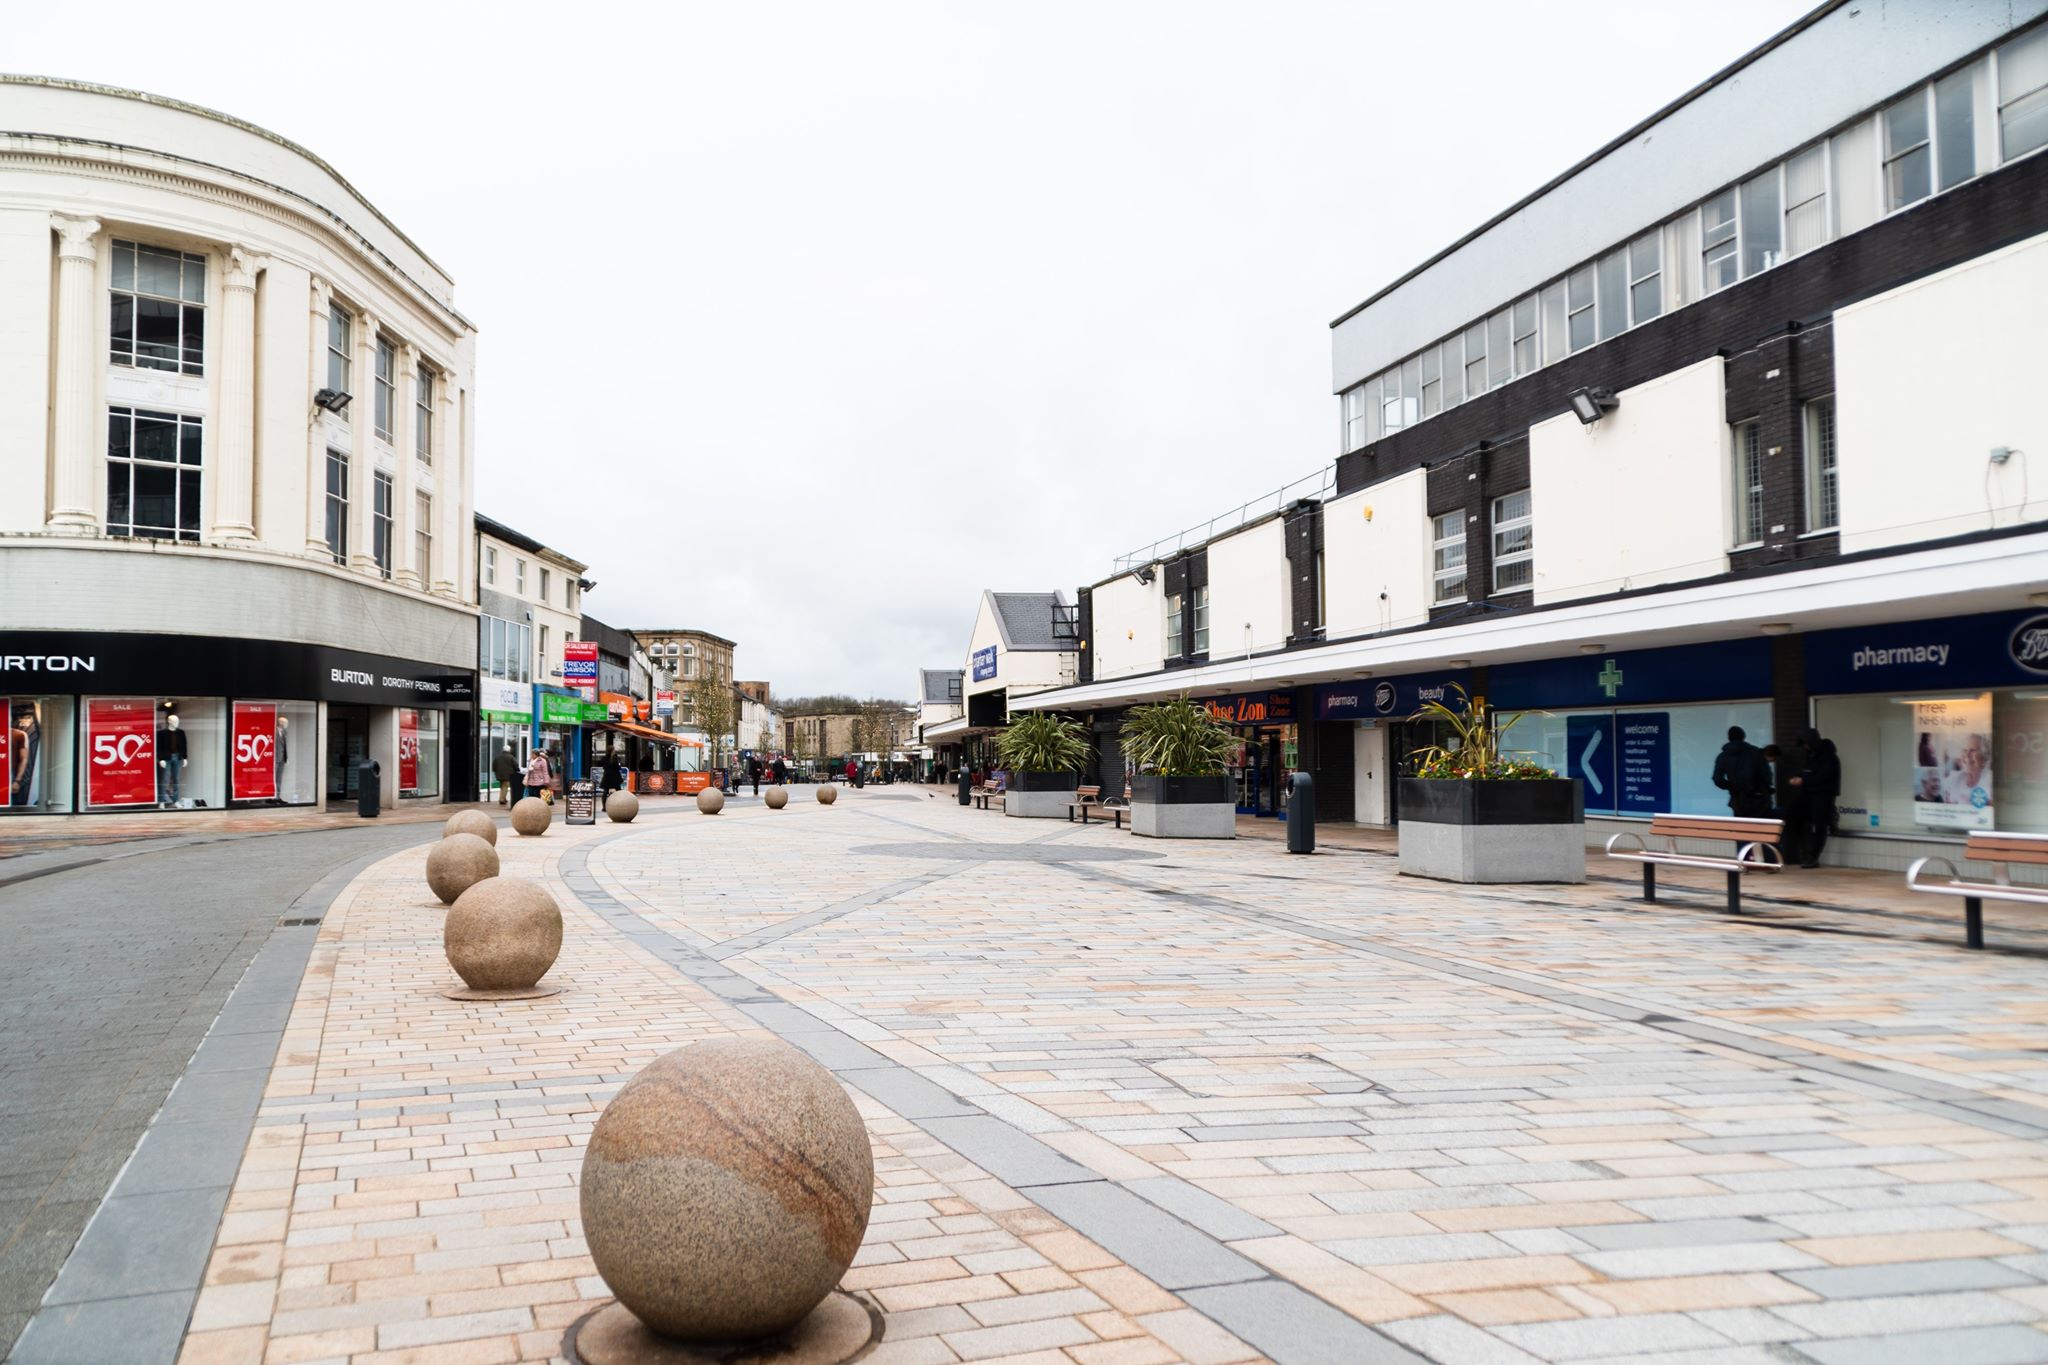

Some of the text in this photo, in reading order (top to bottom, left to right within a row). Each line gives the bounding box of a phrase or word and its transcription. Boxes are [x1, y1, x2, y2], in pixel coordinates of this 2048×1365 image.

[0, 655, 95, 671] RTON
[1853, 644, 1950, 671] pharmacy
[331, 668, 373, 685] BURTON
[382, 676, 440, 692] DOROTHY PERKINS
[1418, 686, 1445, 701] beauty
[1204, 697, 1267, 721] Shoe Zon
[1328, 694, 1358, 709] pharmacy
[1919, 703, 1947, 714] Free
[1625, 725, 1659, 733] welcome
[1920, 717, 1939, 726] NHS
[1952, 716, 1968, 728] jab
[1839, 806, 1867, 815] Opticians
